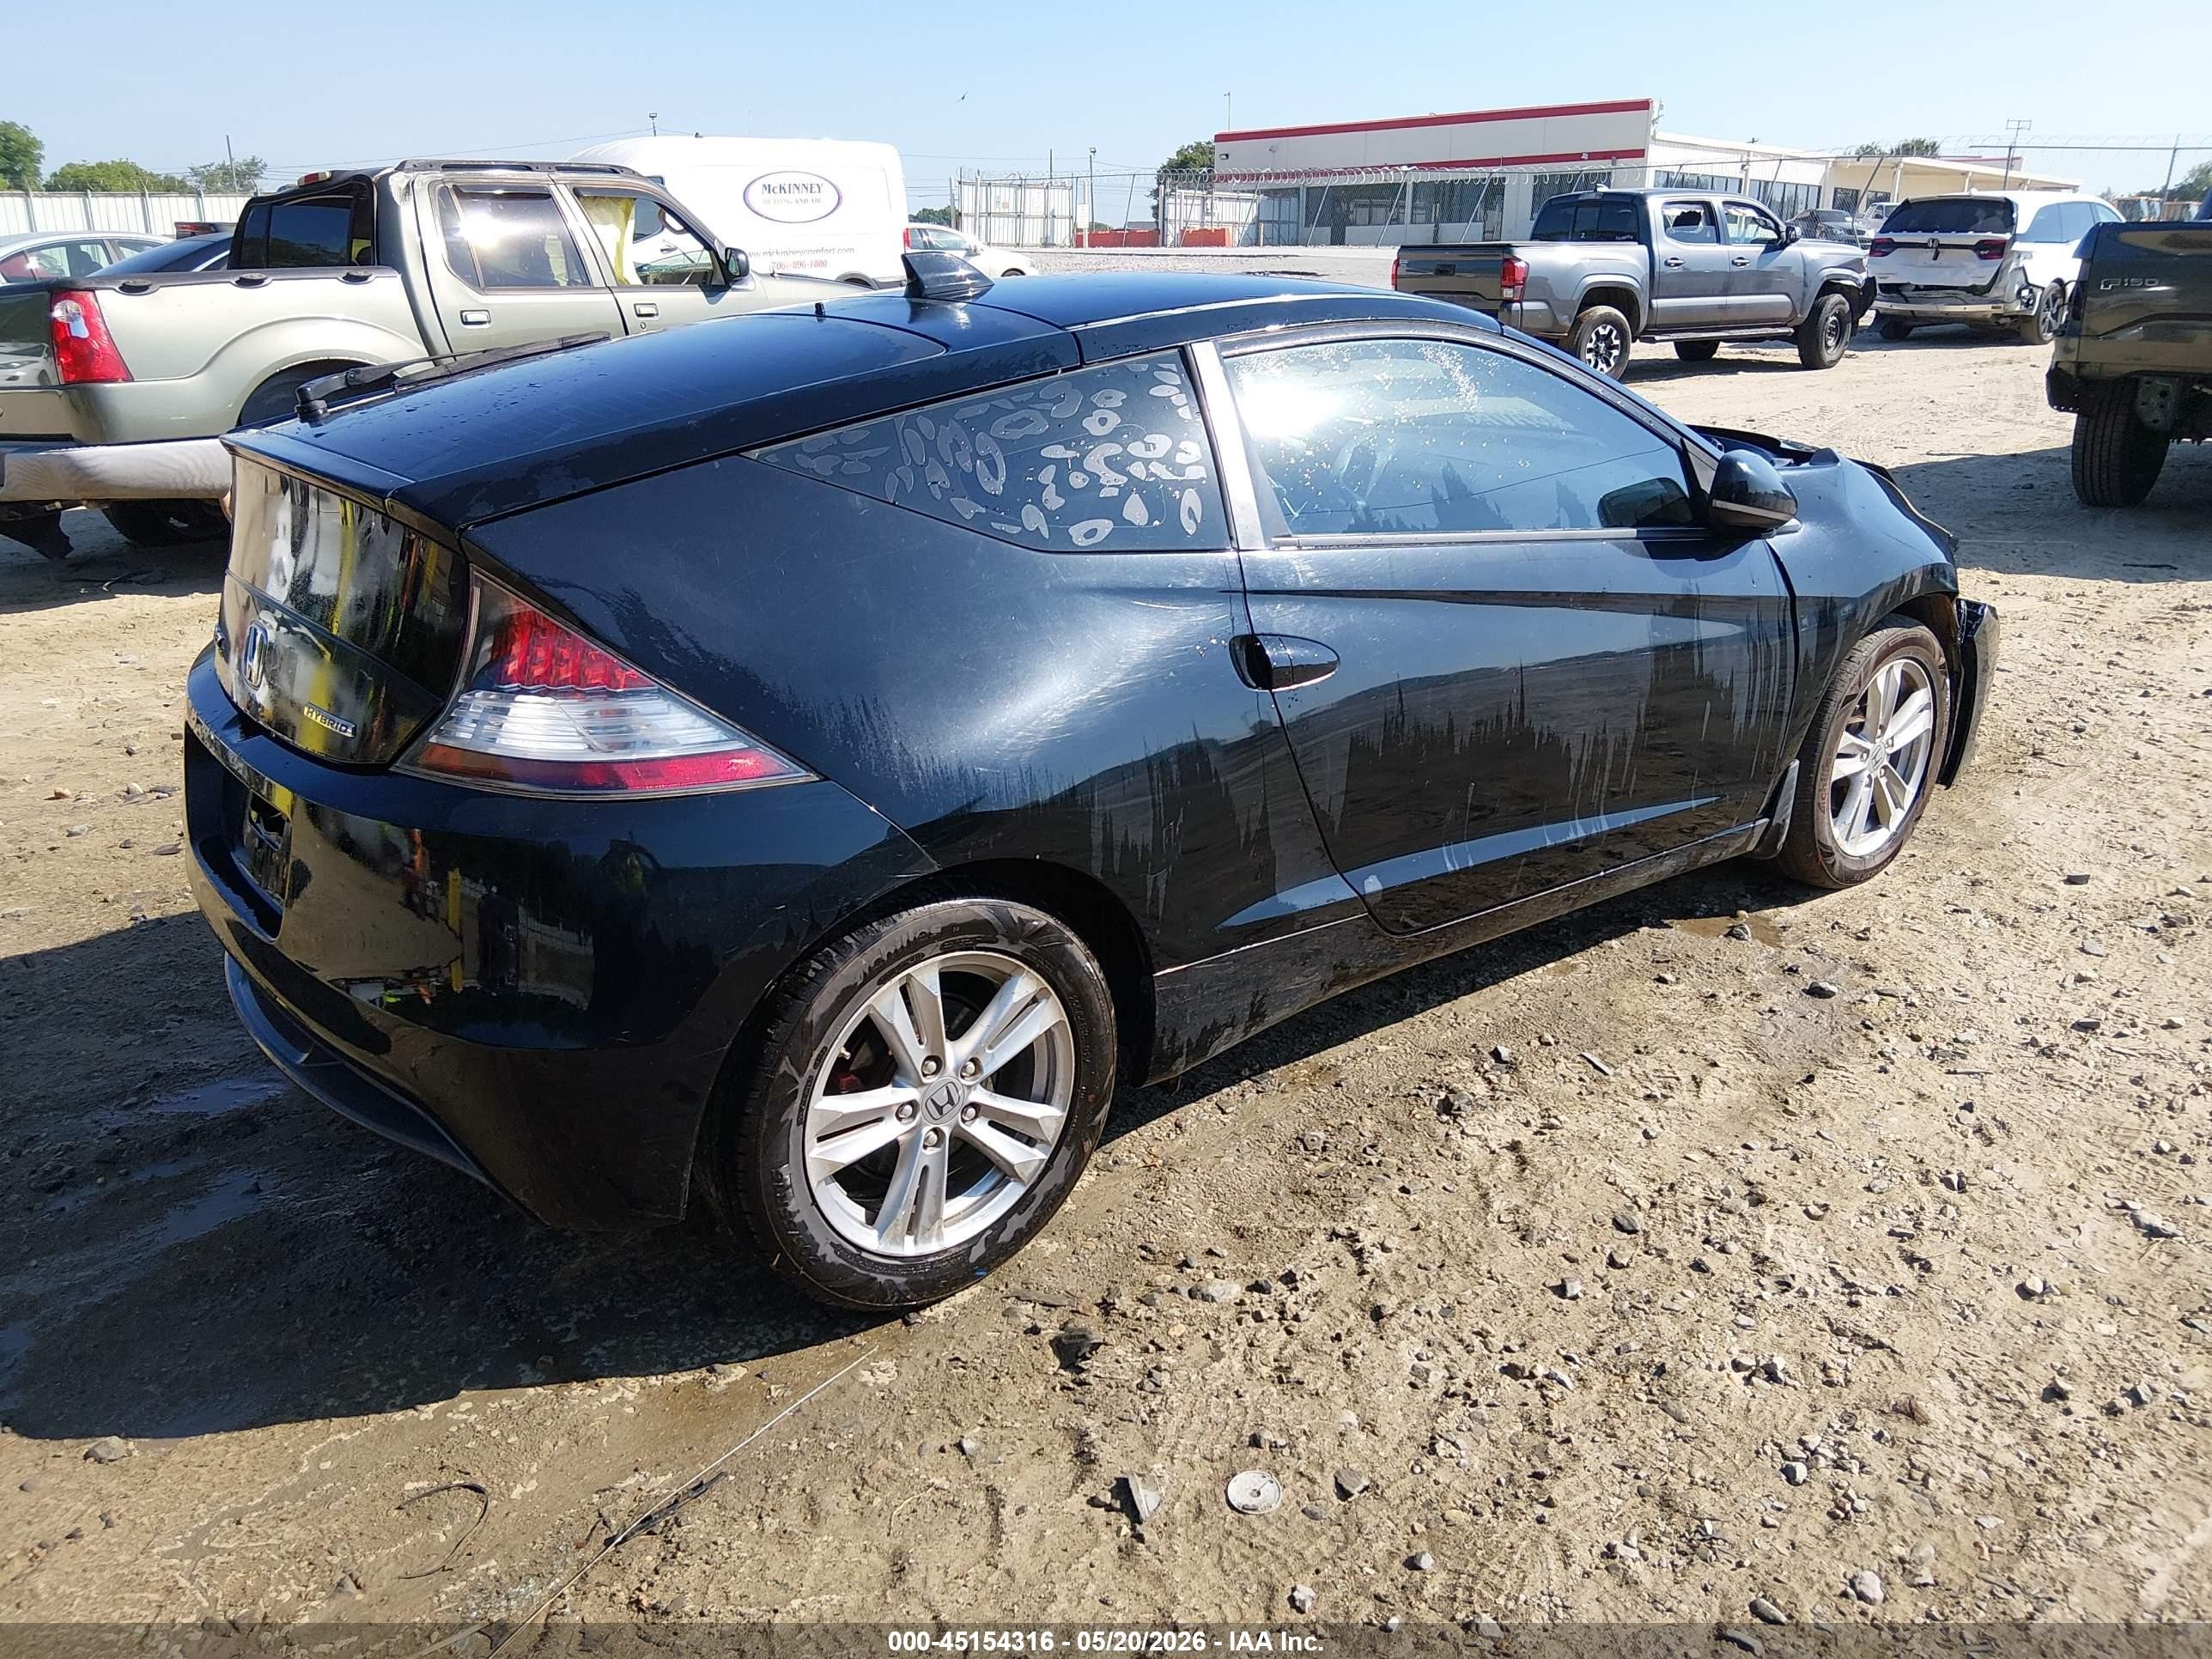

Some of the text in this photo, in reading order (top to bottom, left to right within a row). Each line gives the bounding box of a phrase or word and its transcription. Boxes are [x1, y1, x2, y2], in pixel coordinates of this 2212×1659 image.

[762, 183, 823, 193] McKINNEY
[749, 247, 854, 257] ww.mckinneycomfort.com
[306, 706, 349, 733] HYBRID
